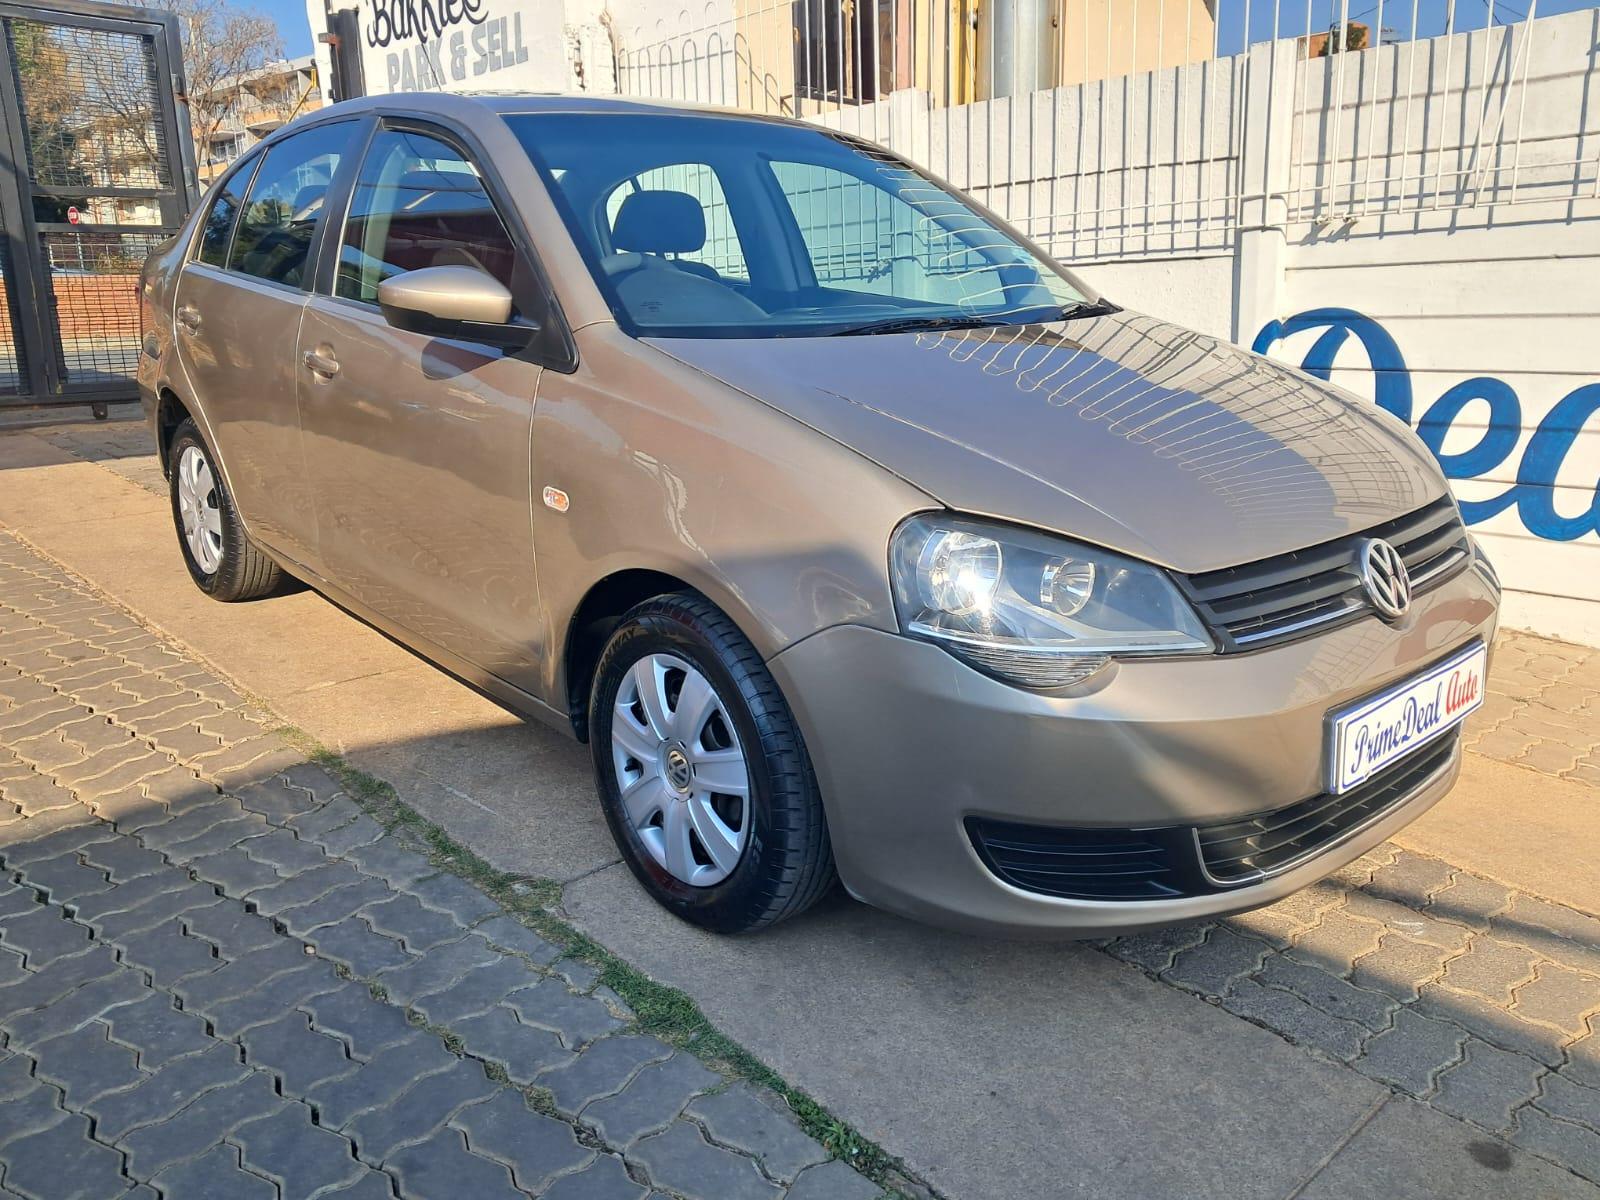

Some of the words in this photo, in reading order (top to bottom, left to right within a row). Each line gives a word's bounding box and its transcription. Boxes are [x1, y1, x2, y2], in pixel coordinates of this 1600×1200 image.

[386, 38, 447, 92] PARK
[450, 30, 467, 81] &
[471, 11, 529, 76] SELL
[1445, 670, 1479, 716] Auto
